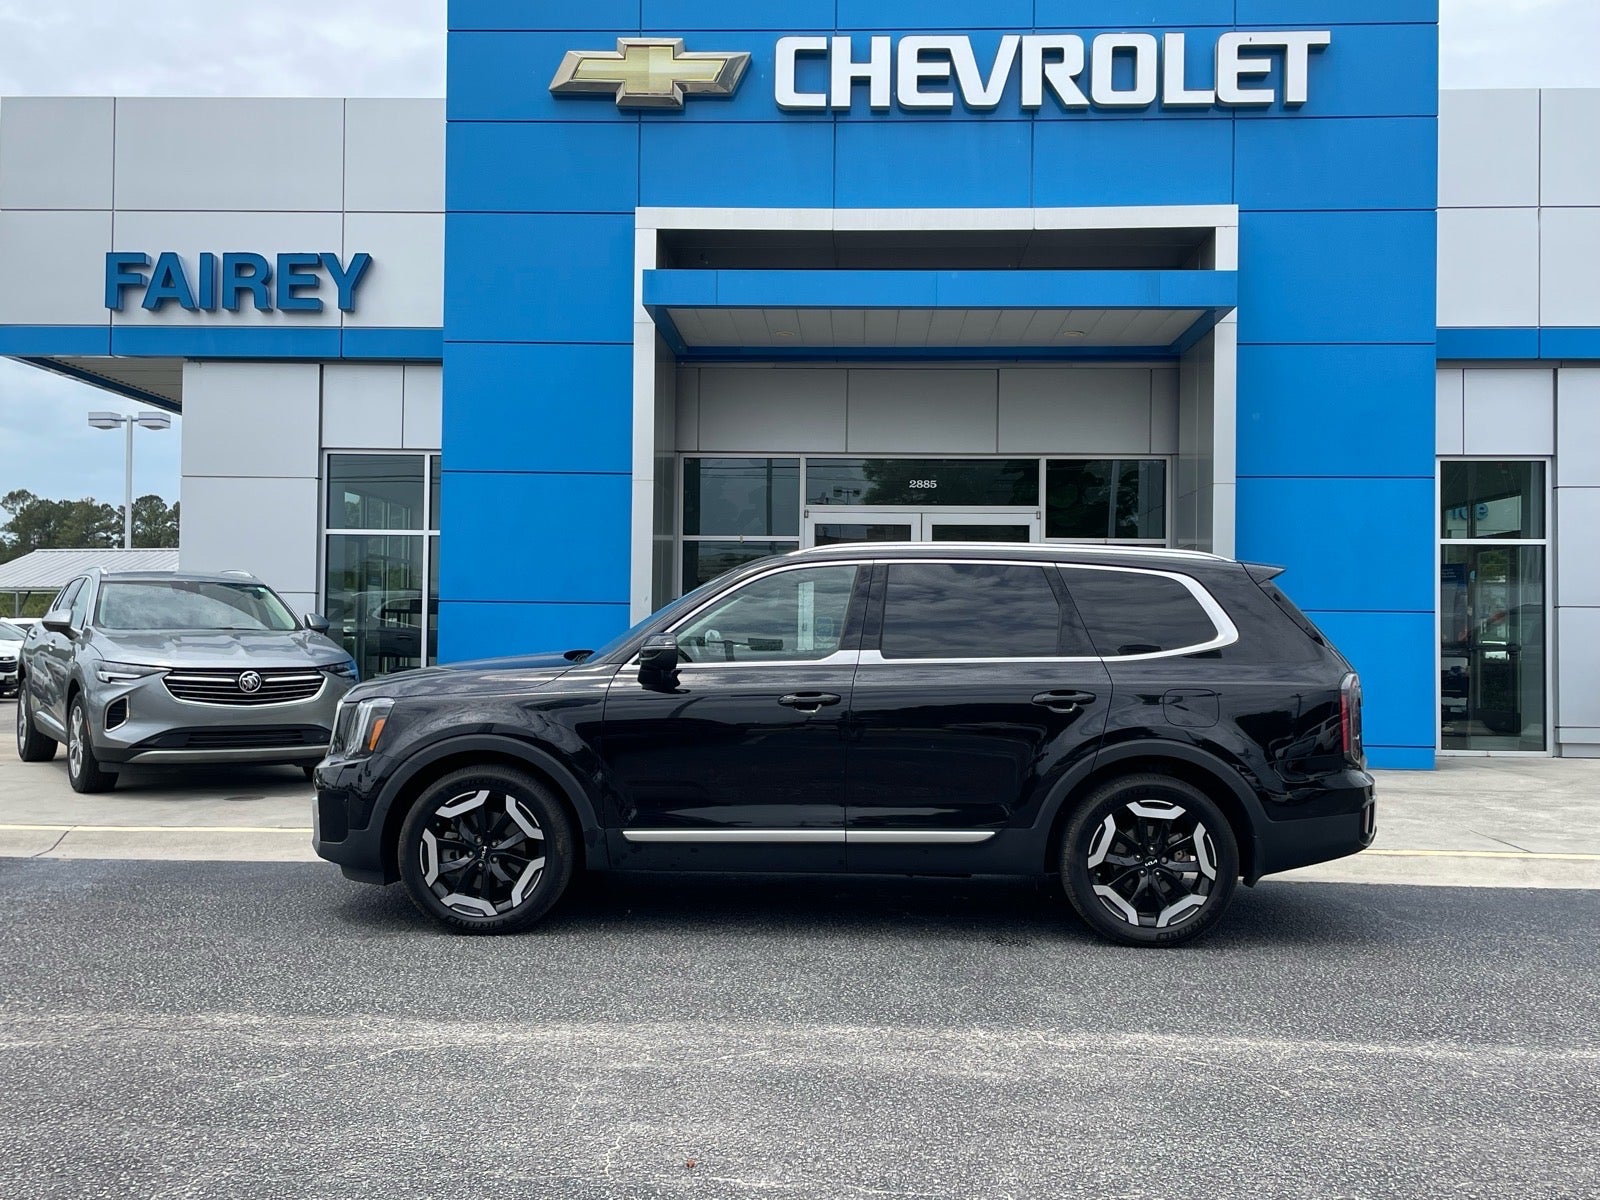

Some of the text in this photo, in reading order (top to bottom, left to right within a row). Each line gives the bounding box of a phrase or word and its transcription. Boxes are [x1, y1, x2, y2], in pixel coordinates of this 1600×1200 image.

[774, 30, 1332, 110] CHEVROLET
[104, 251, 373, 313] FAIREY
[908, 479, 938, 489] 2885
